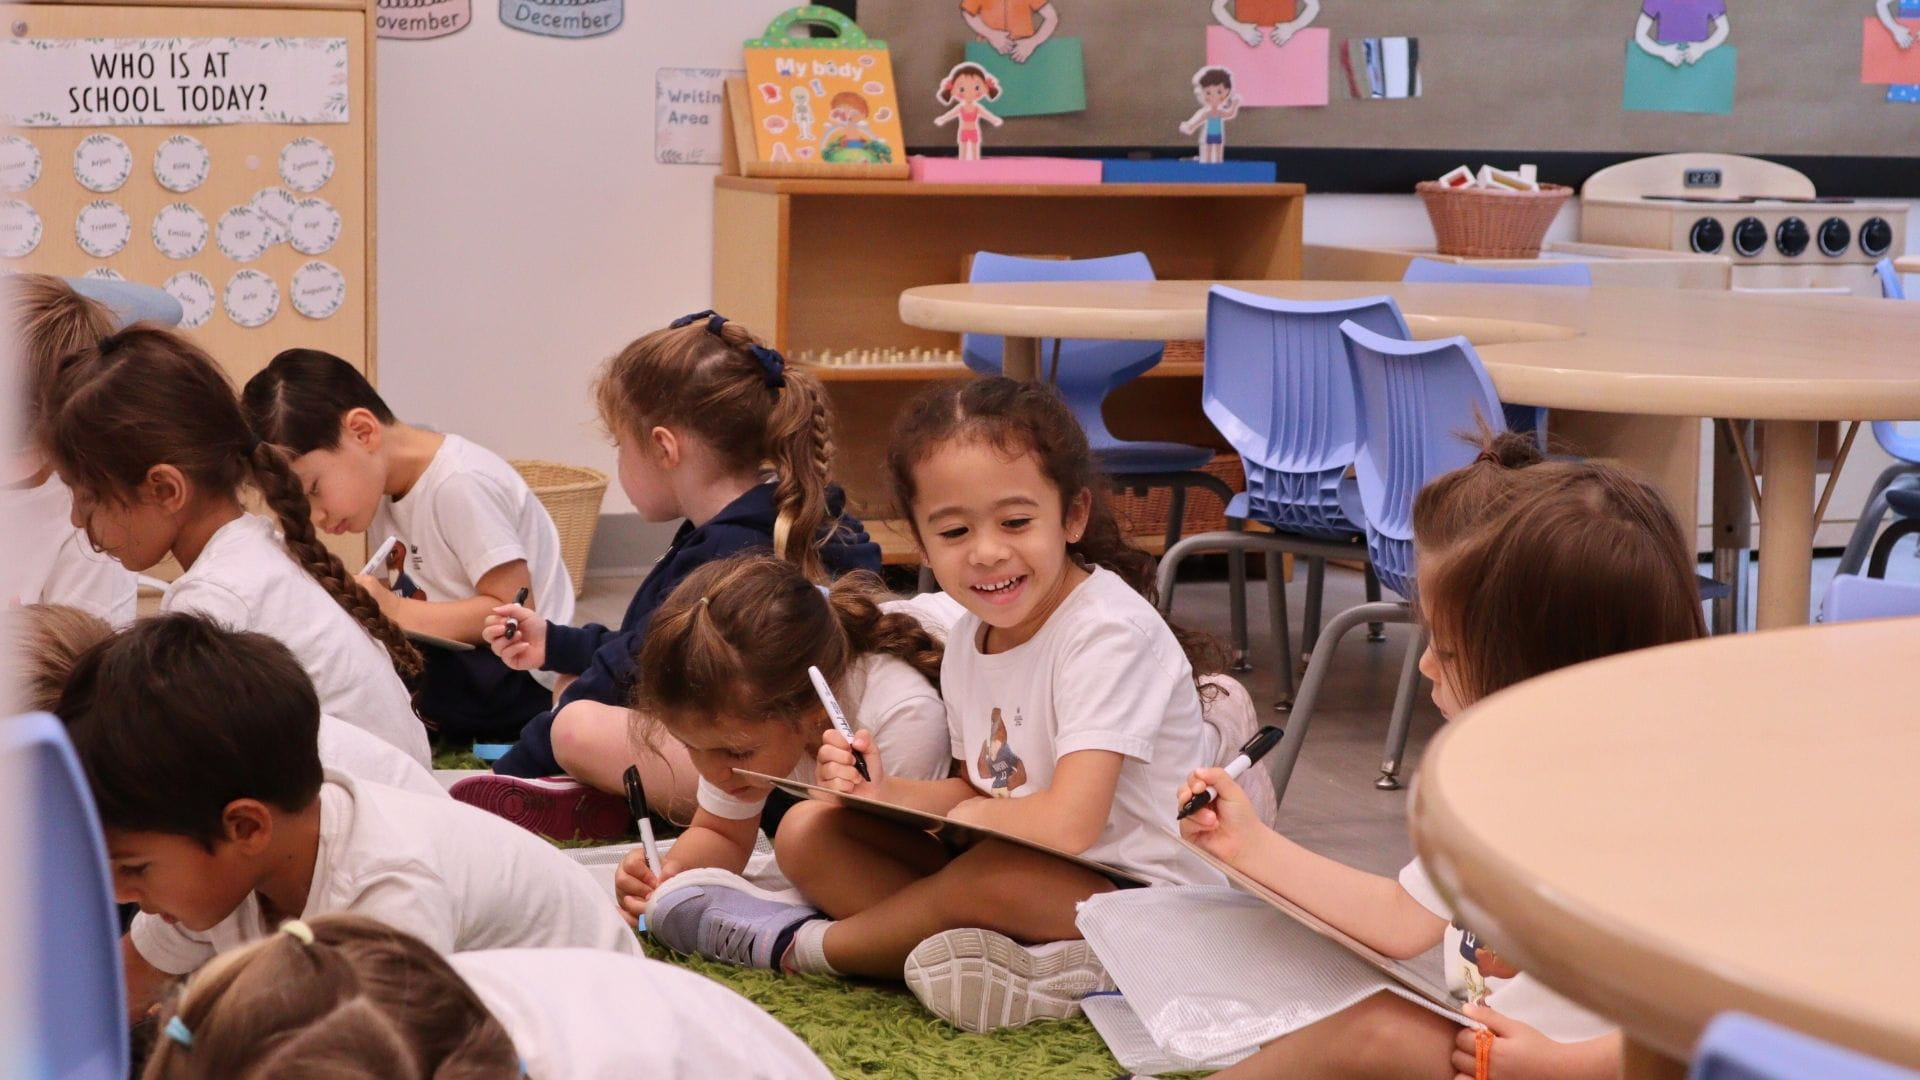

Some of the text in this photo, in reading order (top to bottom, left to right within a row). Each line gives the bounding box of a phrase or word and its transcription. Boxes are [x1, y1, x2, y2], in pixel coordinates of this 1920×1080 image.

[376, 11, 461, 31] ovember
[515, 4, 613, 30] December
[90, 52, 230, 79] WHO IS AT
[775, 57, 863, 81] My body
[69, 84, 269, 114] SCHOOL TODAY?
[667, 89, 722, 103] Writin
[668, 110, 710, 125] Area
